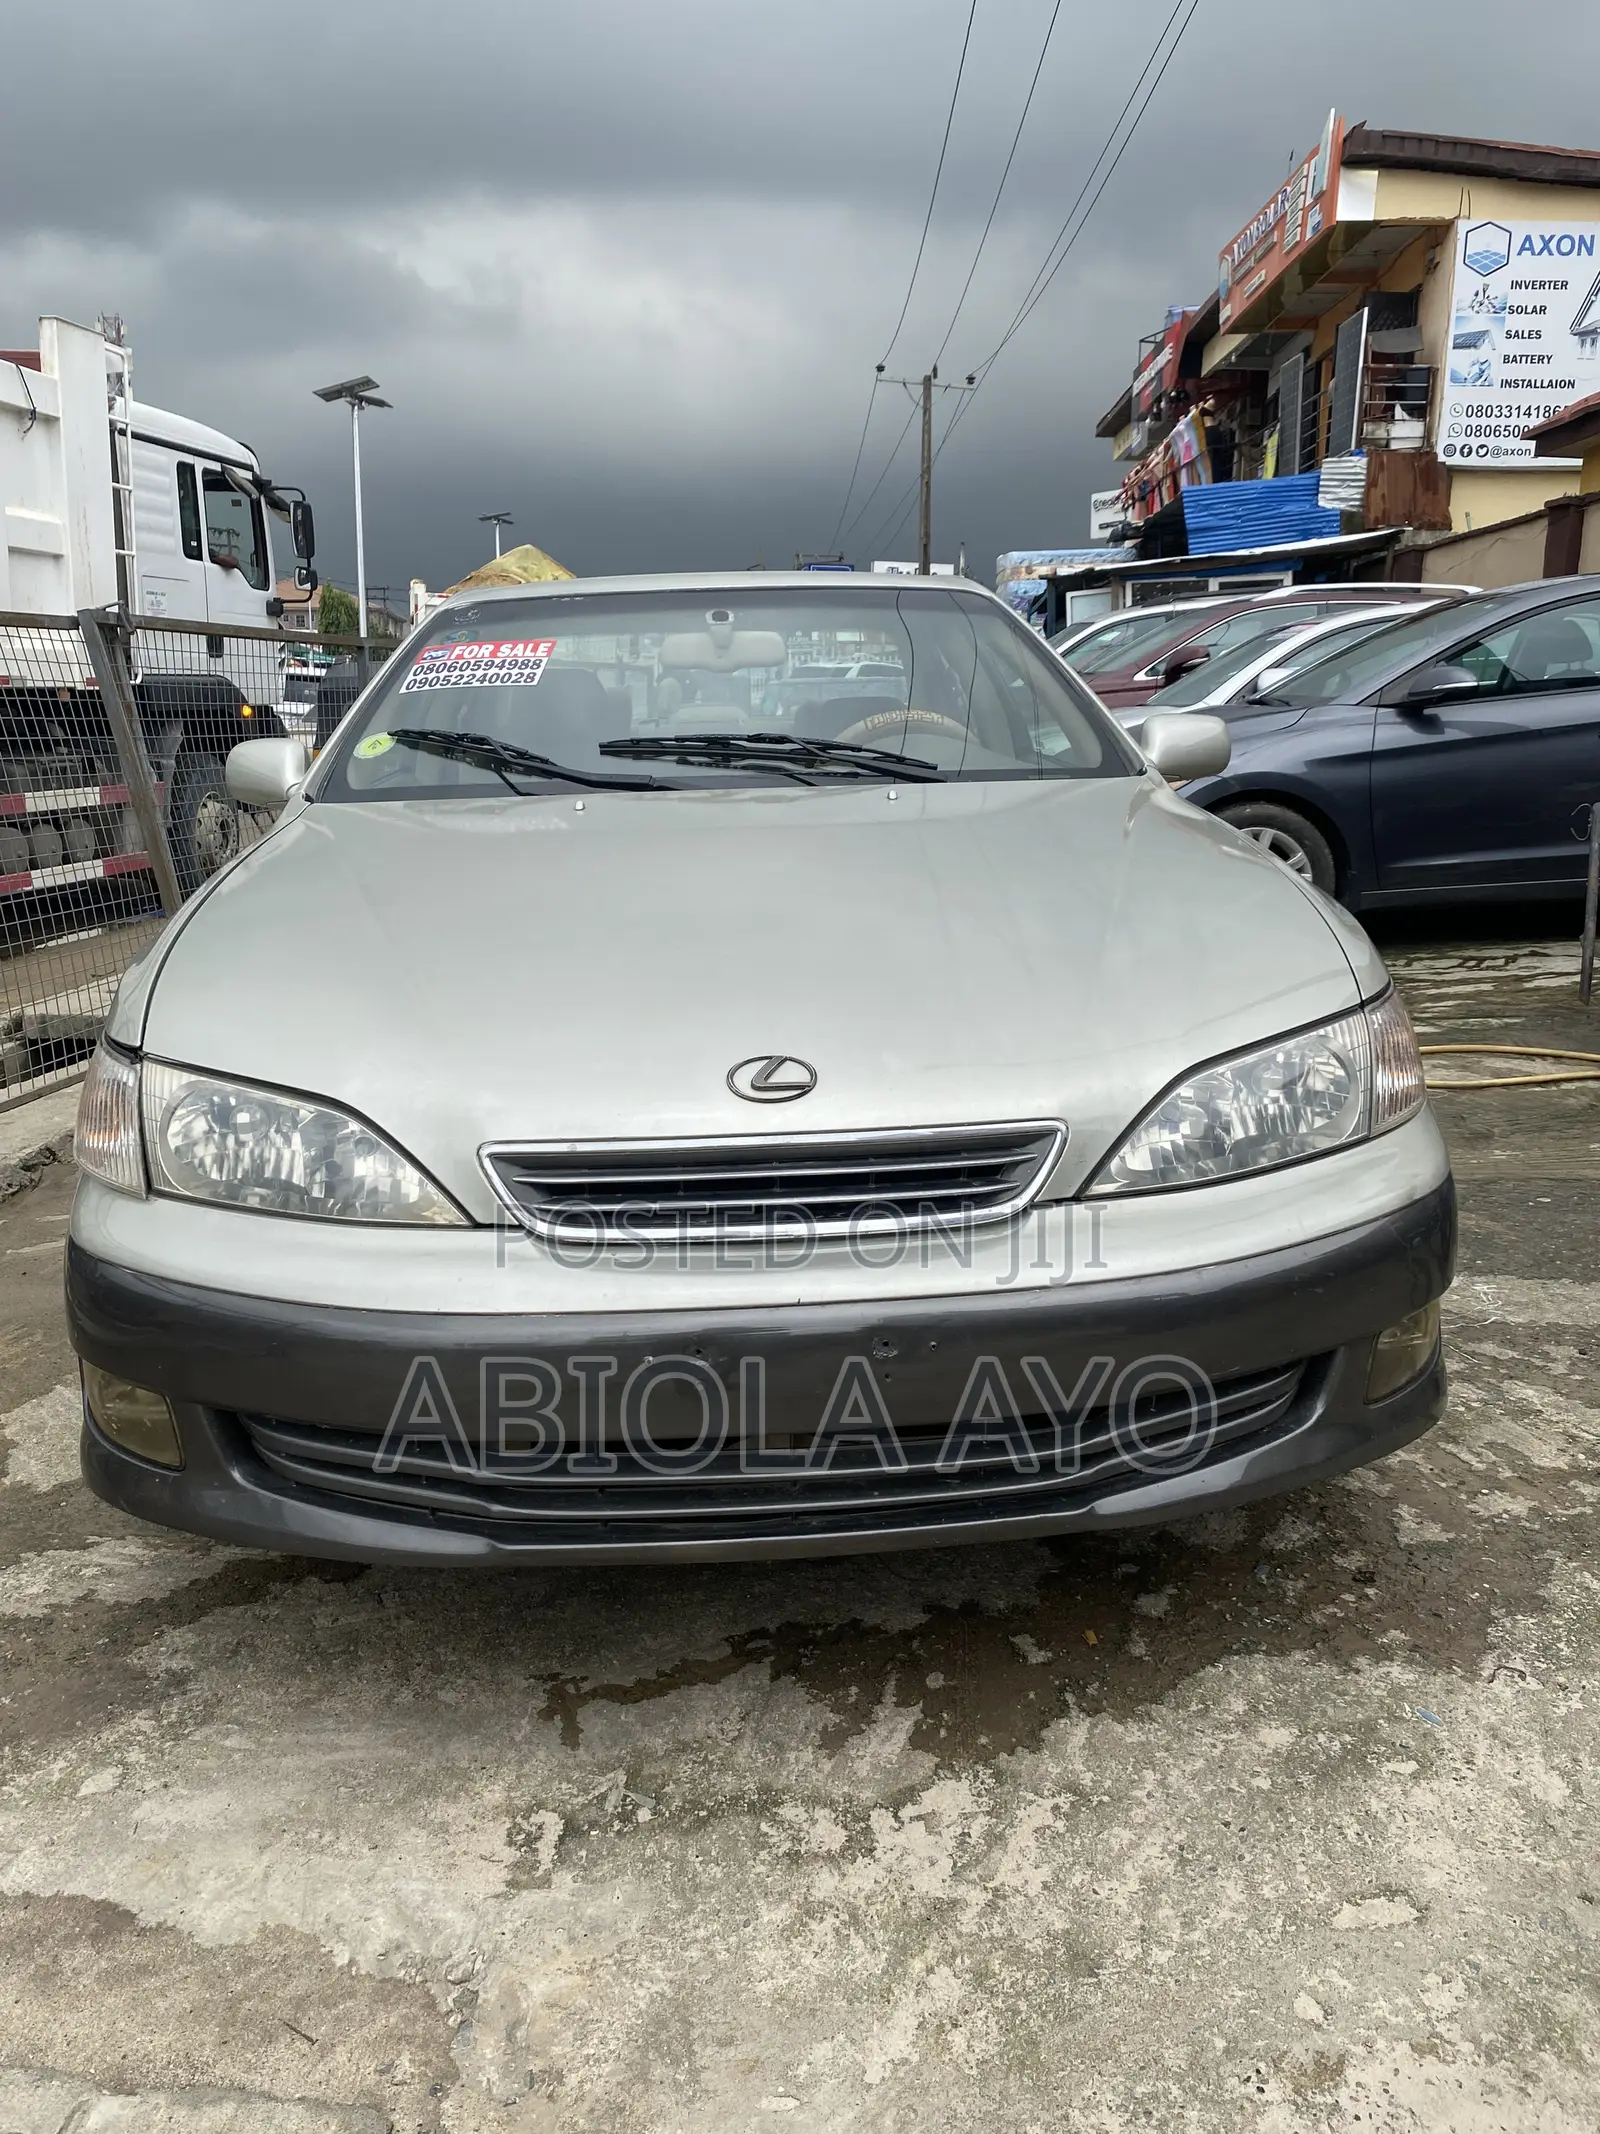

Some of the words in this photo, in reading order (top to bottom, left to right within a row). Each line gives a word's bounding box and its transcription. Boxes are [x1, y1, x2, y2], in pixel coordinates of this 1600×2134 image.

[1516, 234, 1595, 257] AXON
[1510, 279, 1569, 291] INVERTER
[1507, 304, 1548, 316] SOLAR
[1505, 329, 1542, 340] SALES
[1502, 354, 1553, 365] BATTERY
[1500, 378, 1576, 390] INSTALLAION
[1465, 404, 1571, 419] 0803314186
[450, 644, 495, 660] FOR
[497, 642, 552, 658] SALE
[412, 658, 543, 677] 08060594988
[405, 672, 537, 691] 09052240028
